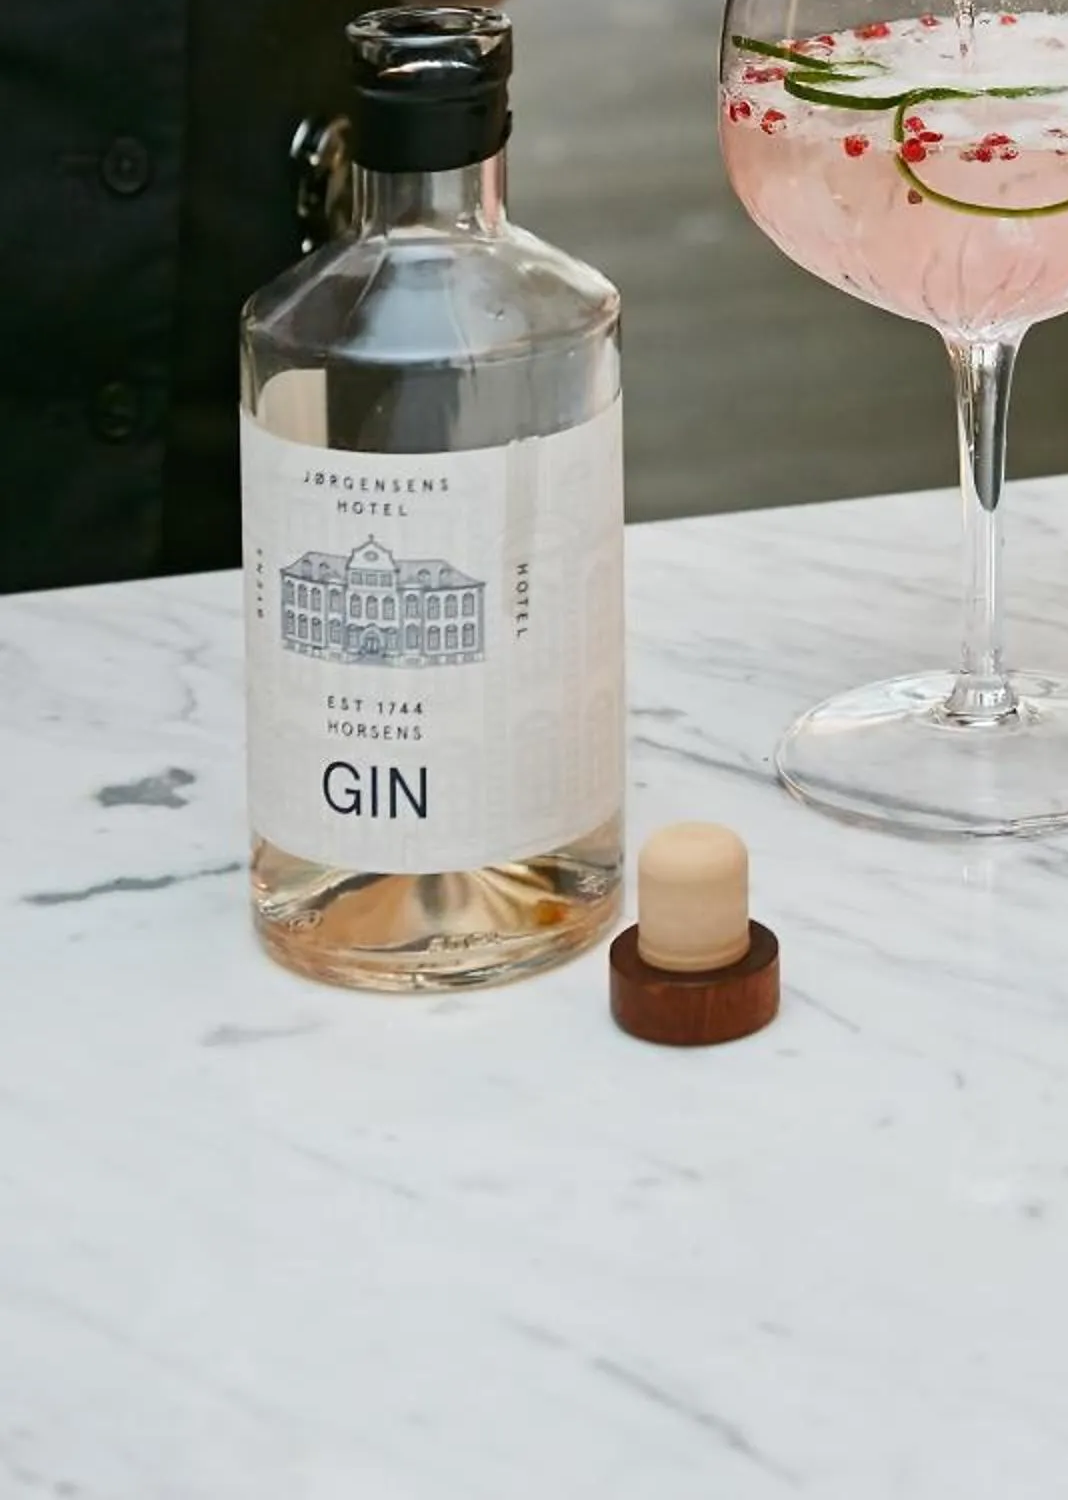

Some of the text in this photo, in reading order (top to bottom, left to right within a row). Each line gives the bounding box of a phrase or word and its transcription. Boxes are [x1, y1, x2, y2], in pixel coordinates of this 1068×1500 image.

[303, 470, 449, 494] JØRGENSENS
[336, 499, 408, 517] HOTEL
[516, 562, 529, 639] HOTEL
[327, 695, 423, 715] EST 1744
[327, 719, 423, 741] HORSENS
[322, 761, 427, 819] GIN
